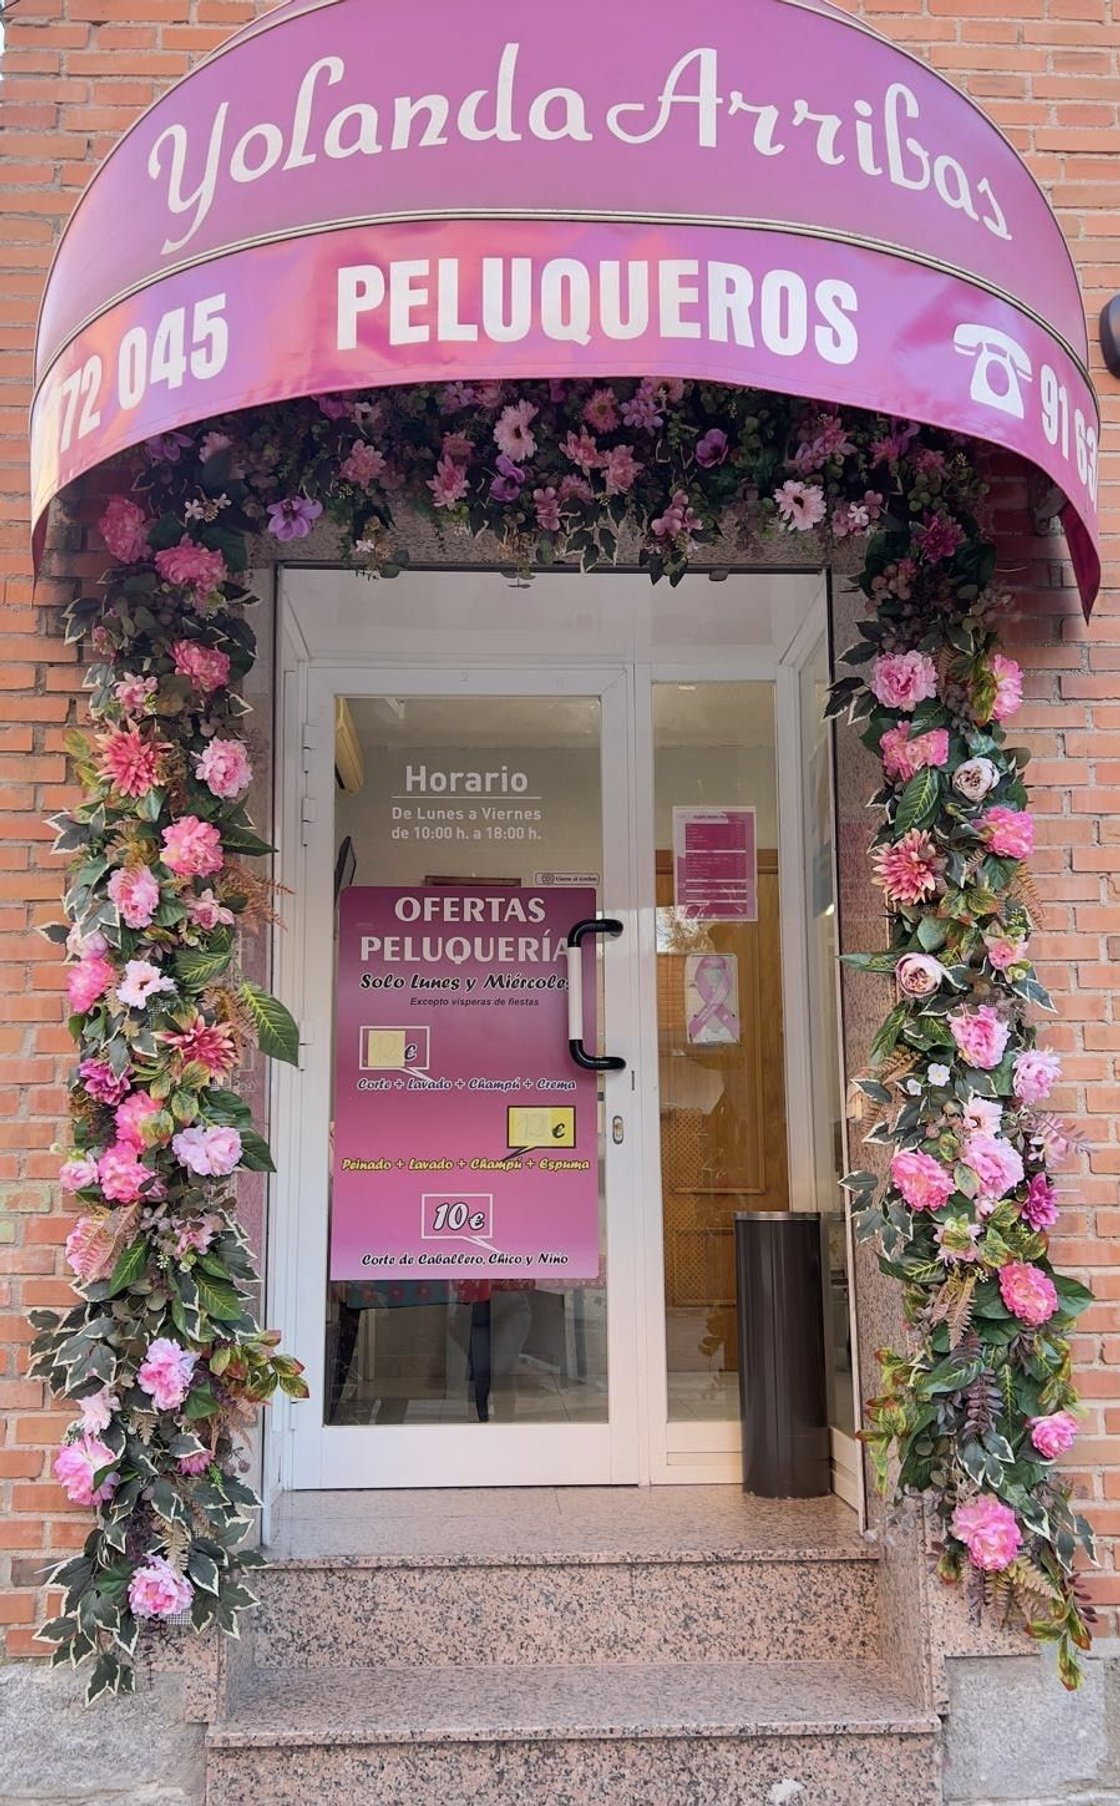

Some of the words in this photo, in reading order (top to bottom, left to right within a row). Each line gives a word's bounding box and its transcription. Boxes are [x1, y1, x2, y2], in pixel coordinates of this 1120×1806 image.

[147, 42, 593, 256] Yolanda
[606, 47, 1012, 241] Arribas
[336, 257, 859, 365] PELUQUEROS
[117, 293, 229, 410] 045
[1040, 364, 1069, 462] 91
[406, 766, 528, 793] Horario
[392, 807, 412, 820] De
[417, 807, 464, 820] Lunes
[469, 810, 477, 820] a
[482, 807, 541, 820] Viernes
[392, 827, 409, 839] de
[414, 827, 452, 839] 10:00
[456, 827, 469, 839] h.
[473, 830, 481, 839] a
[487, 827, 525, 839] 18:00
[528, 827, 541, 840] h.
[395, 897, 546, 923] OFERTAS
[361, 929, 568, 964] PELUQUERÍA
[361, 974, 404, 989] Solo
[411, 975, 460, 990] Lunes
[466, 978, 477, 992] y
[410, 997, 449, 1007] Excepto
[494, 997, 506, 1006] de
[508, 997, 539, 1006] fiestas
[357, 1078, 391, 1090] Corte
[408, 1078, 452, 1090] Lavado
[469, 1077, 520, 1093] Champú
[537, 1078, 577, 1090] Crema
[341, 1157, 392, 1171] Peinado
[408, 1158, 454, 1170] Lavado
[470, 1156, 522, 1173] Champú
[539, 1157, 590, 1172] Espuma
[361, 1253, 396, 1265] Corte
[398, 1253, 414, 1265] de
[488, 1252, 522, 1265] Chico
[525, 1256, 533, 1266] y
